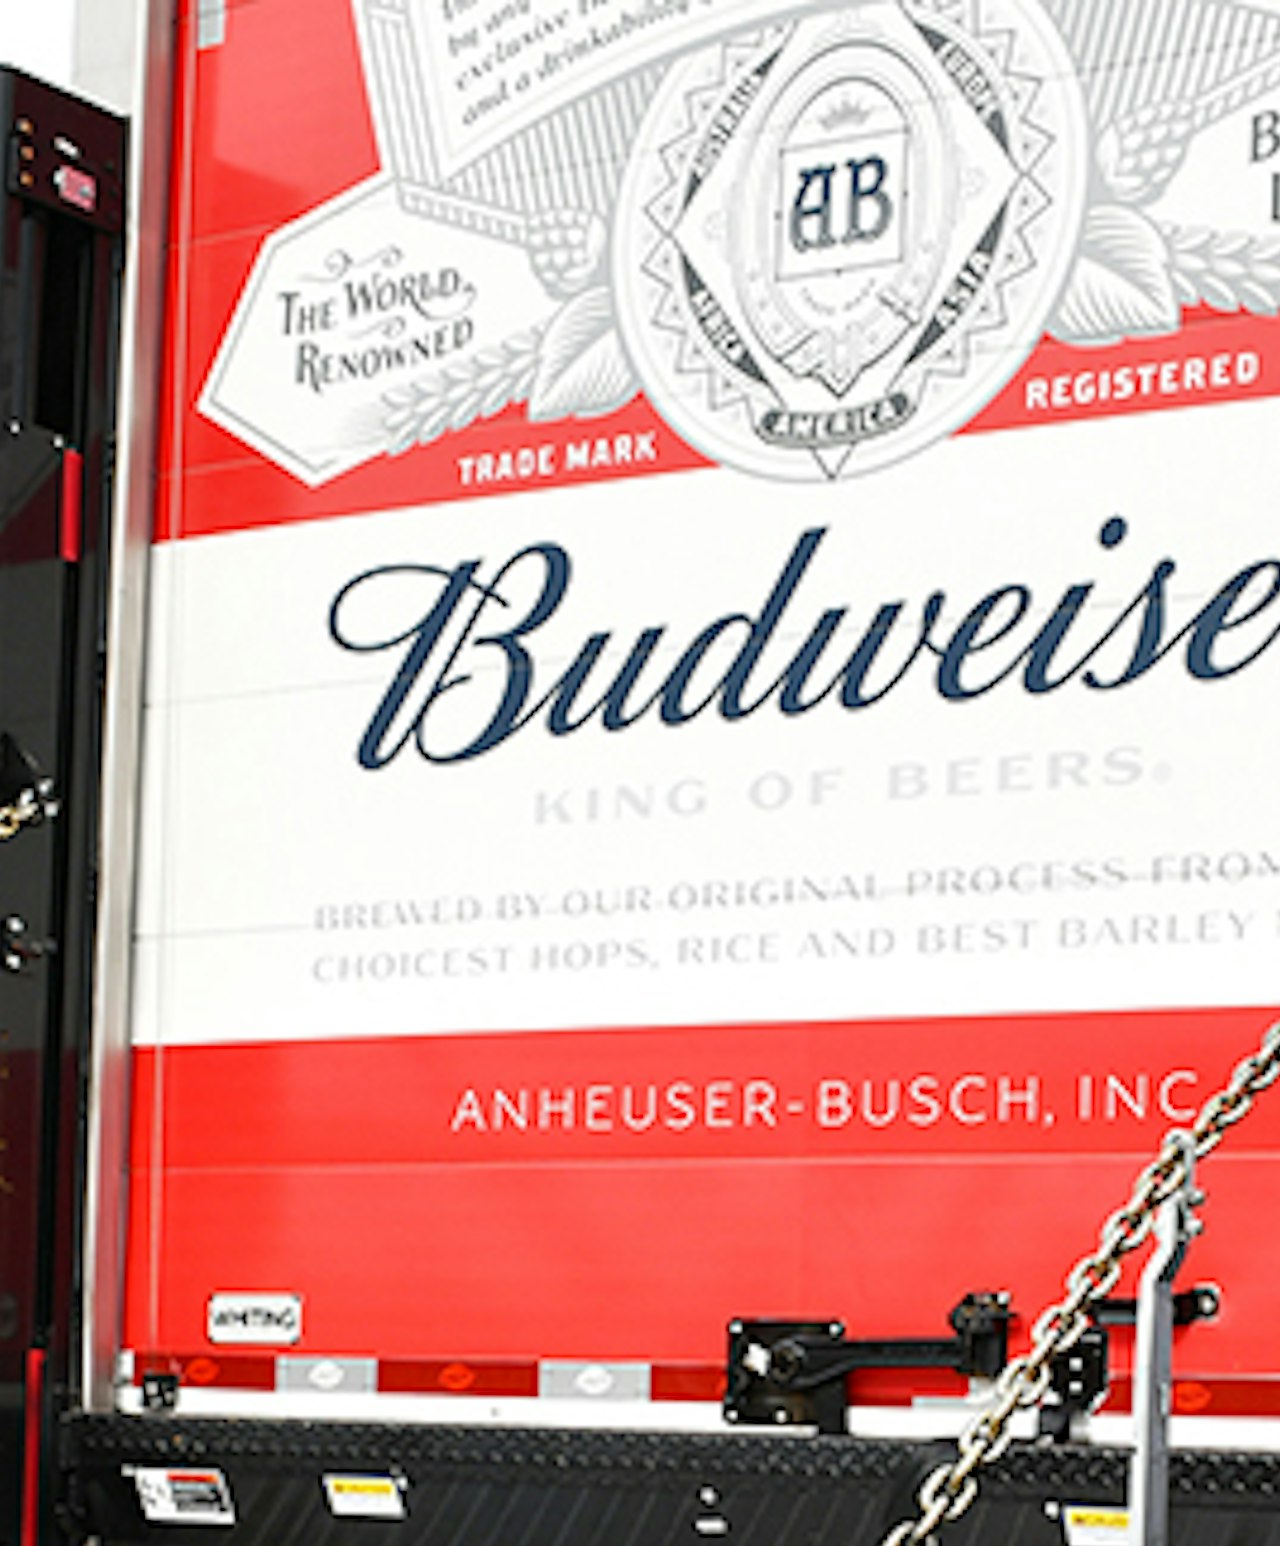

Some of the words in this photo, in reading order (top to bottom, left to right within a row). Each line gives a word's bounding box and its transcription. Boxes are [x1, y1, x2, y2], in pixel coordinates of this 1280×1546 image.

[789, 154, 893, 253] AB
[278, 290, 336, 337] THE
[294, 317, 474, 395] RENOWNED
[1024, 351, 1261, 411] REGISTERED
[458, 443, 557, 486] TRADE
[566, 431, 658, 474] MARK
[533, 778, 710, 826] KING
[749, 766, 845, 812] OF
[314, 895, 482, 932] BREWED
[496, 891, 544, 922] BY
[562, 885, 654, 919] OUR
[668, 872, 881, 912] ORIGINAL
[906, 857, 1128, 898] PROCESS
[313, 946, 514, 984] CHOICEST
[529, 938, 661, 974] HOPS,
[677, 932, 780, 966] RICE
[799, 930, 896, 962] AND
[918, 919, 1040, 955] BEST
[1058, 910, 1257, 950] BARLEY
[451, 1073, 1056, 1132] ANHEUSER-BUSCH,
